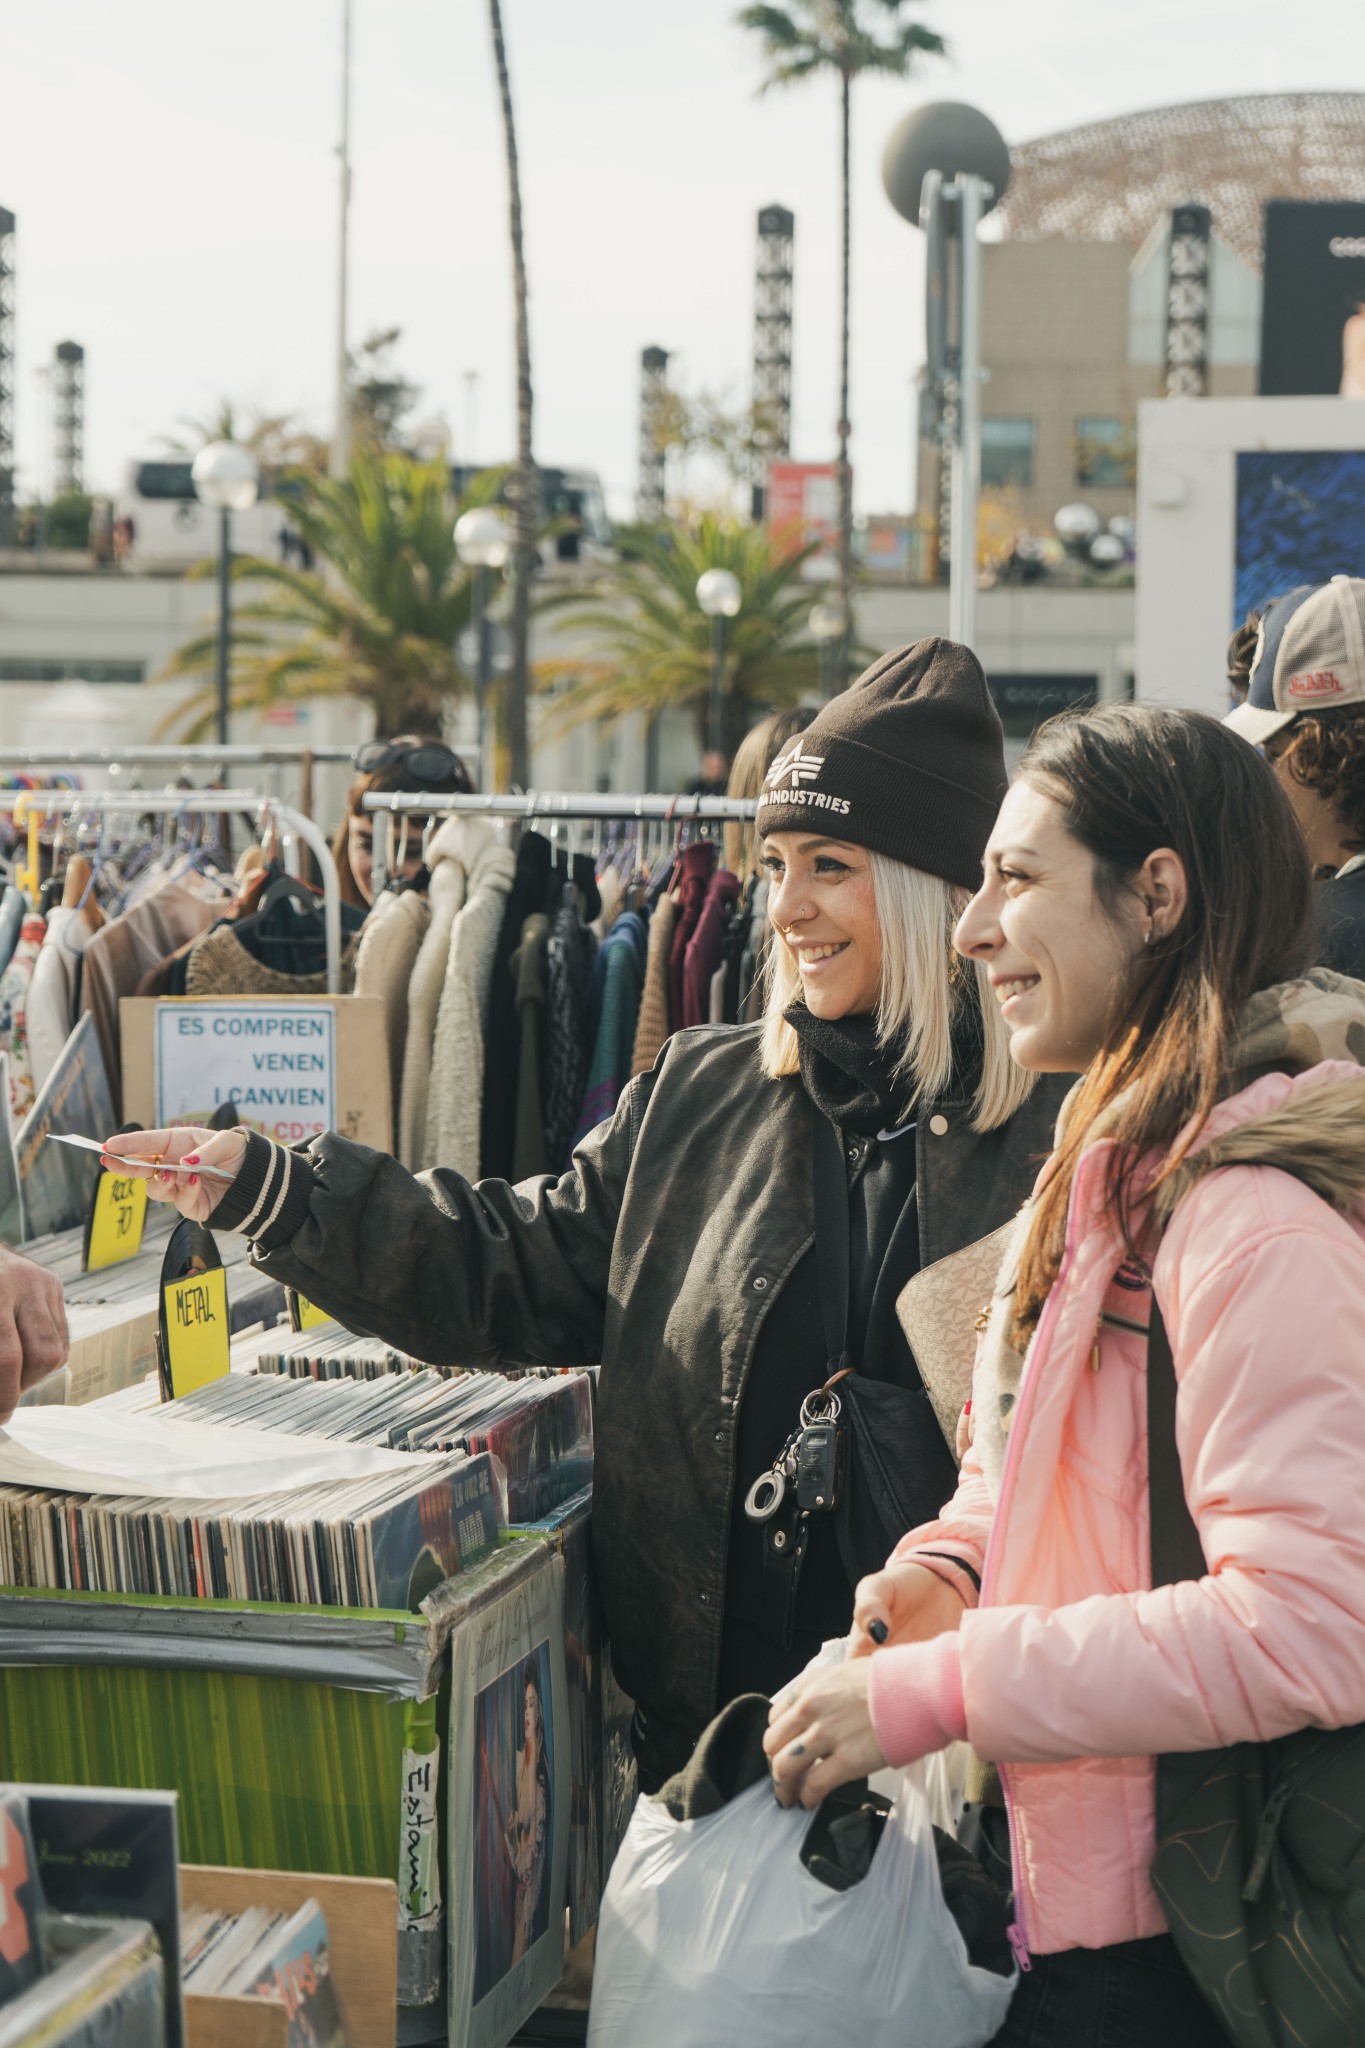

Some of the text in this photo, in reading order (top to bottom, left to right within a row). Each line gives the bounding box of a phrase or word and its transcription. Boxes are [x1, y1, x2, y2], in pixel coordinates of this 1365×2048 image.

[770, 789, 851, 814] INDUSTRIES
[178, 1017, 324, 1037] ES COMPREN
[252, 1053, 325, 1072] VENEN
[214, 1087, 325, 1106] I CANVIEN
[117, 1205, 133, 1239] 70
[176, 1285, 216, 1327] METAL
[81, 1848, 132, 1869] 2022
